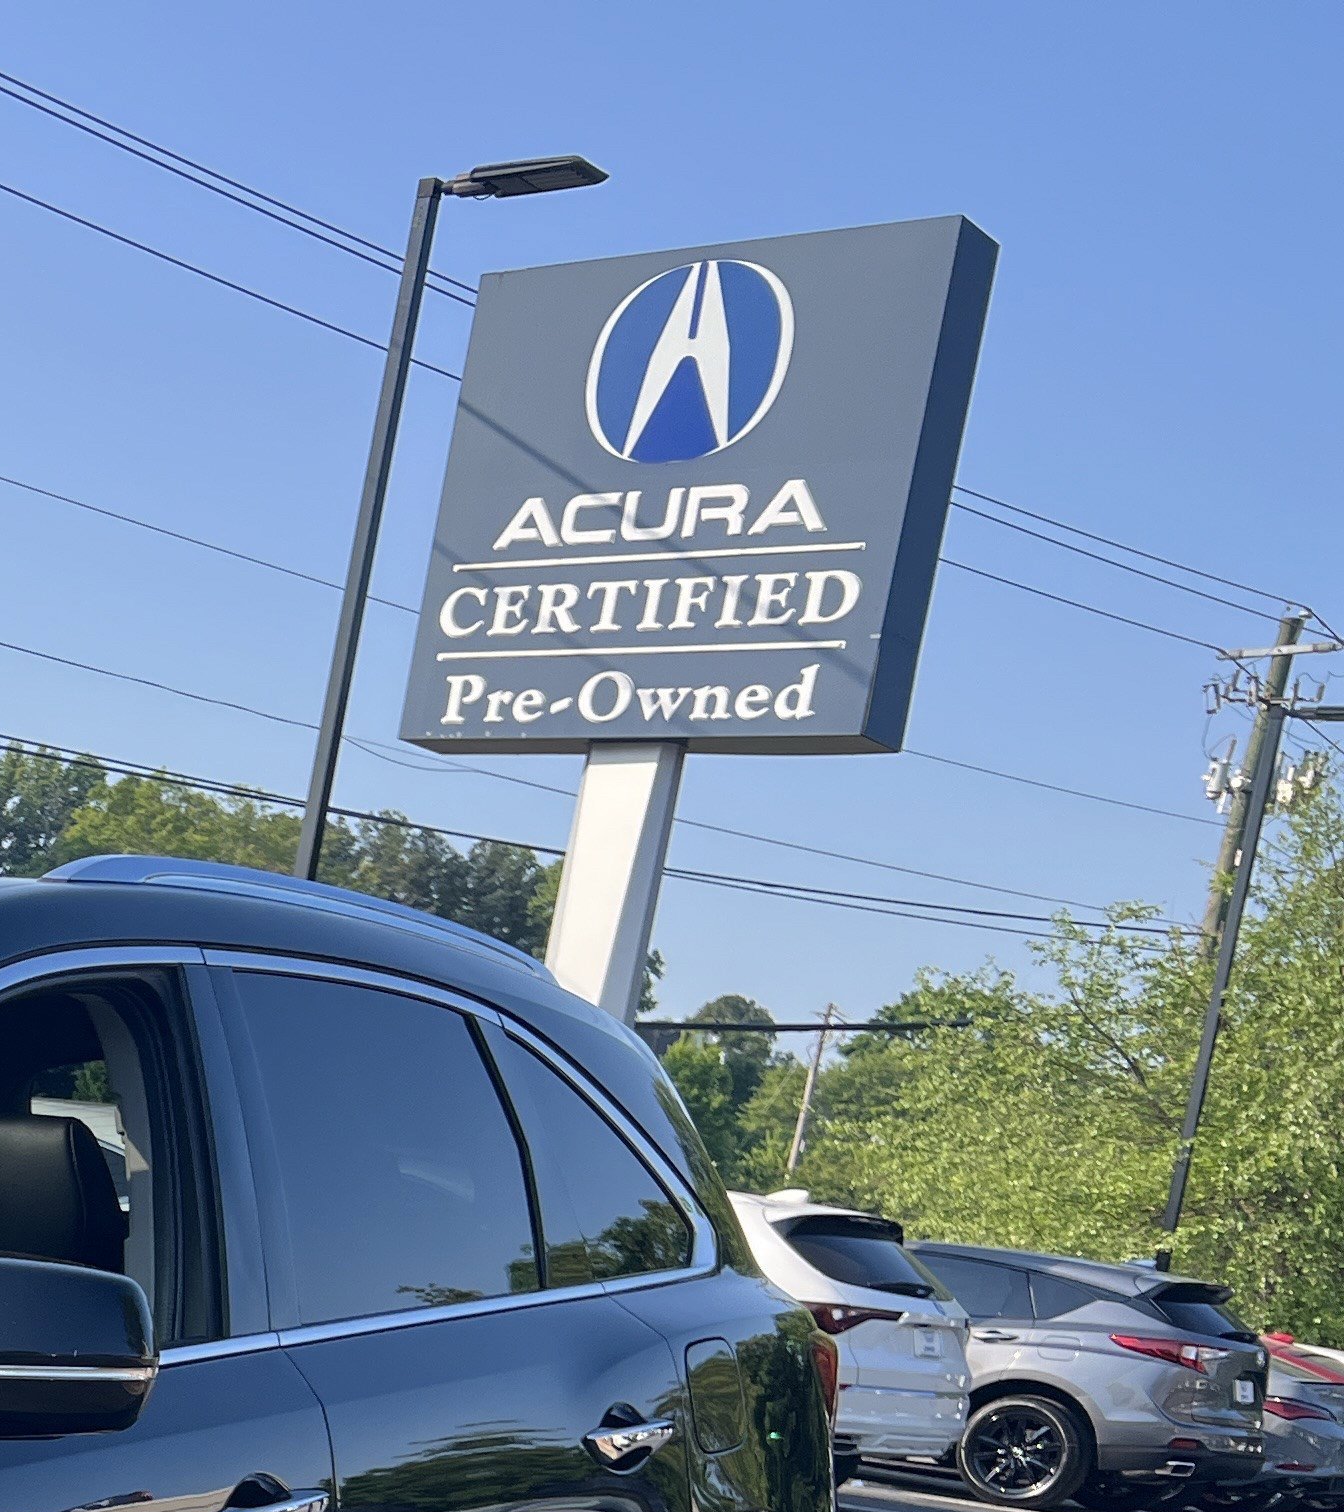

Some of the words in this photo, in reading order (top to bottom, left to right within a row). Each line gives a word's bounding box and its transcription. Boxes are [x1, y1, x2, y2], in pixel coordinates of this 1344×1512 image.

[493, 479, 828, 551] ACURA
[439, 570, 864, 639] CERTIFIED
[441, 664, 820, 725] Pre-Owned
